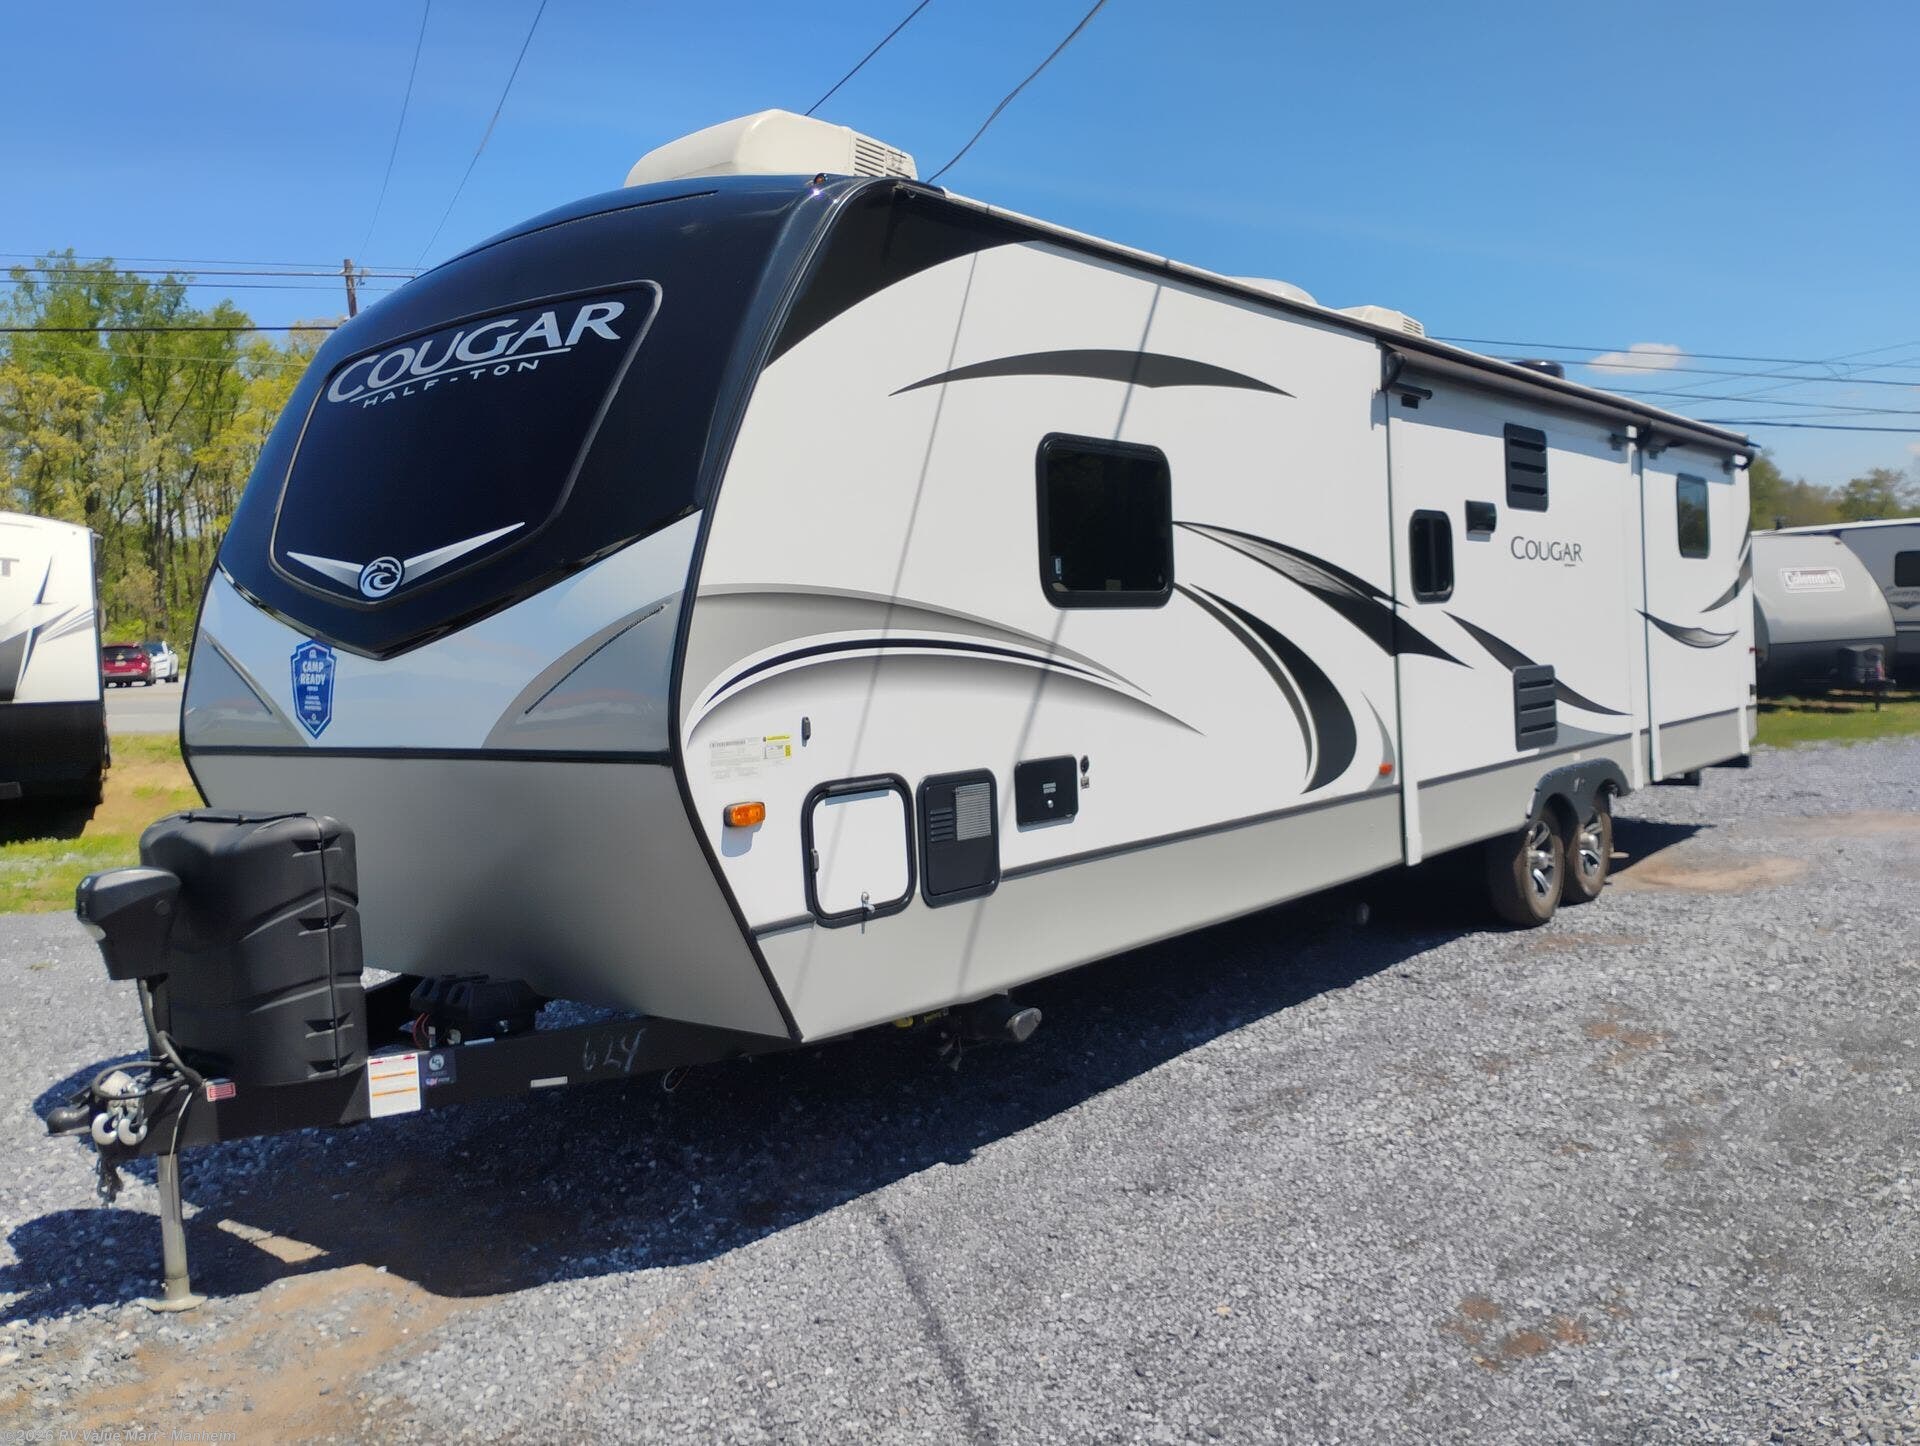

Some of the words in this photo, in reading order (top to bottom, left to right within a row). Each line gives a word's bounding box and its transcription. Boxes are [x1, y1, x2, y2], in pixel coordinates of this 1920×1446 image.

[328, 301, 625, 403] COUGAR
[363, 359, 539, 408] HALF-TON
[1510, 535, 1584, 562] COUGAR
[299, 673, 326, 685] READY
[302, 661, 325, 673] CAMP
